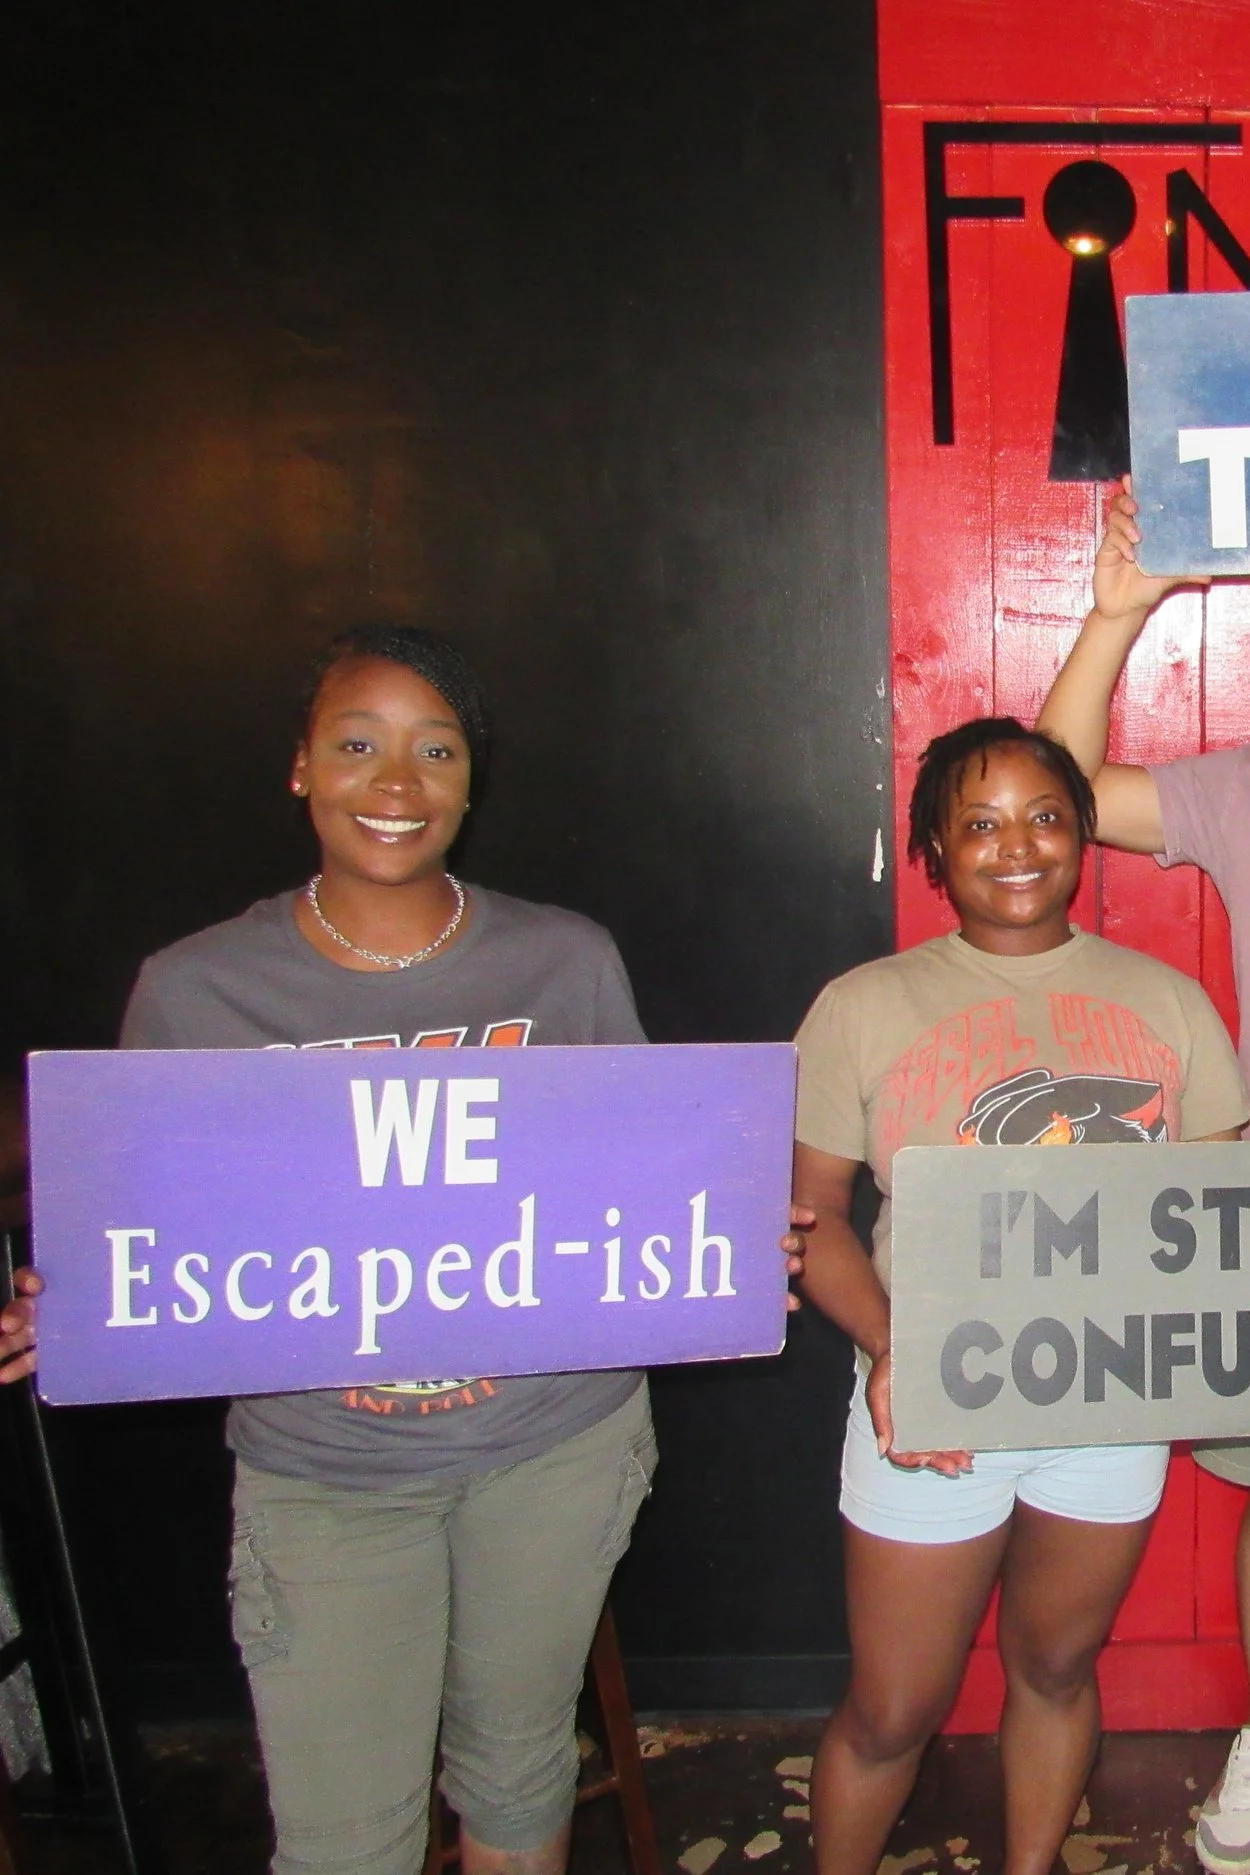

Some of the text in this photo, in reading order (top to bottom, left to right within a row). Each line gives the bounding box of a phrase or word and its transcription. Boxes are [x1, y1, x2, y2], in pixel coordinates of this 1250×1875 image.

[351, 1078, 499, 1187] WE
[105, 1190, 737, 1355] Escaped-ish
[979, 1189, 1100, 1280] I'M
